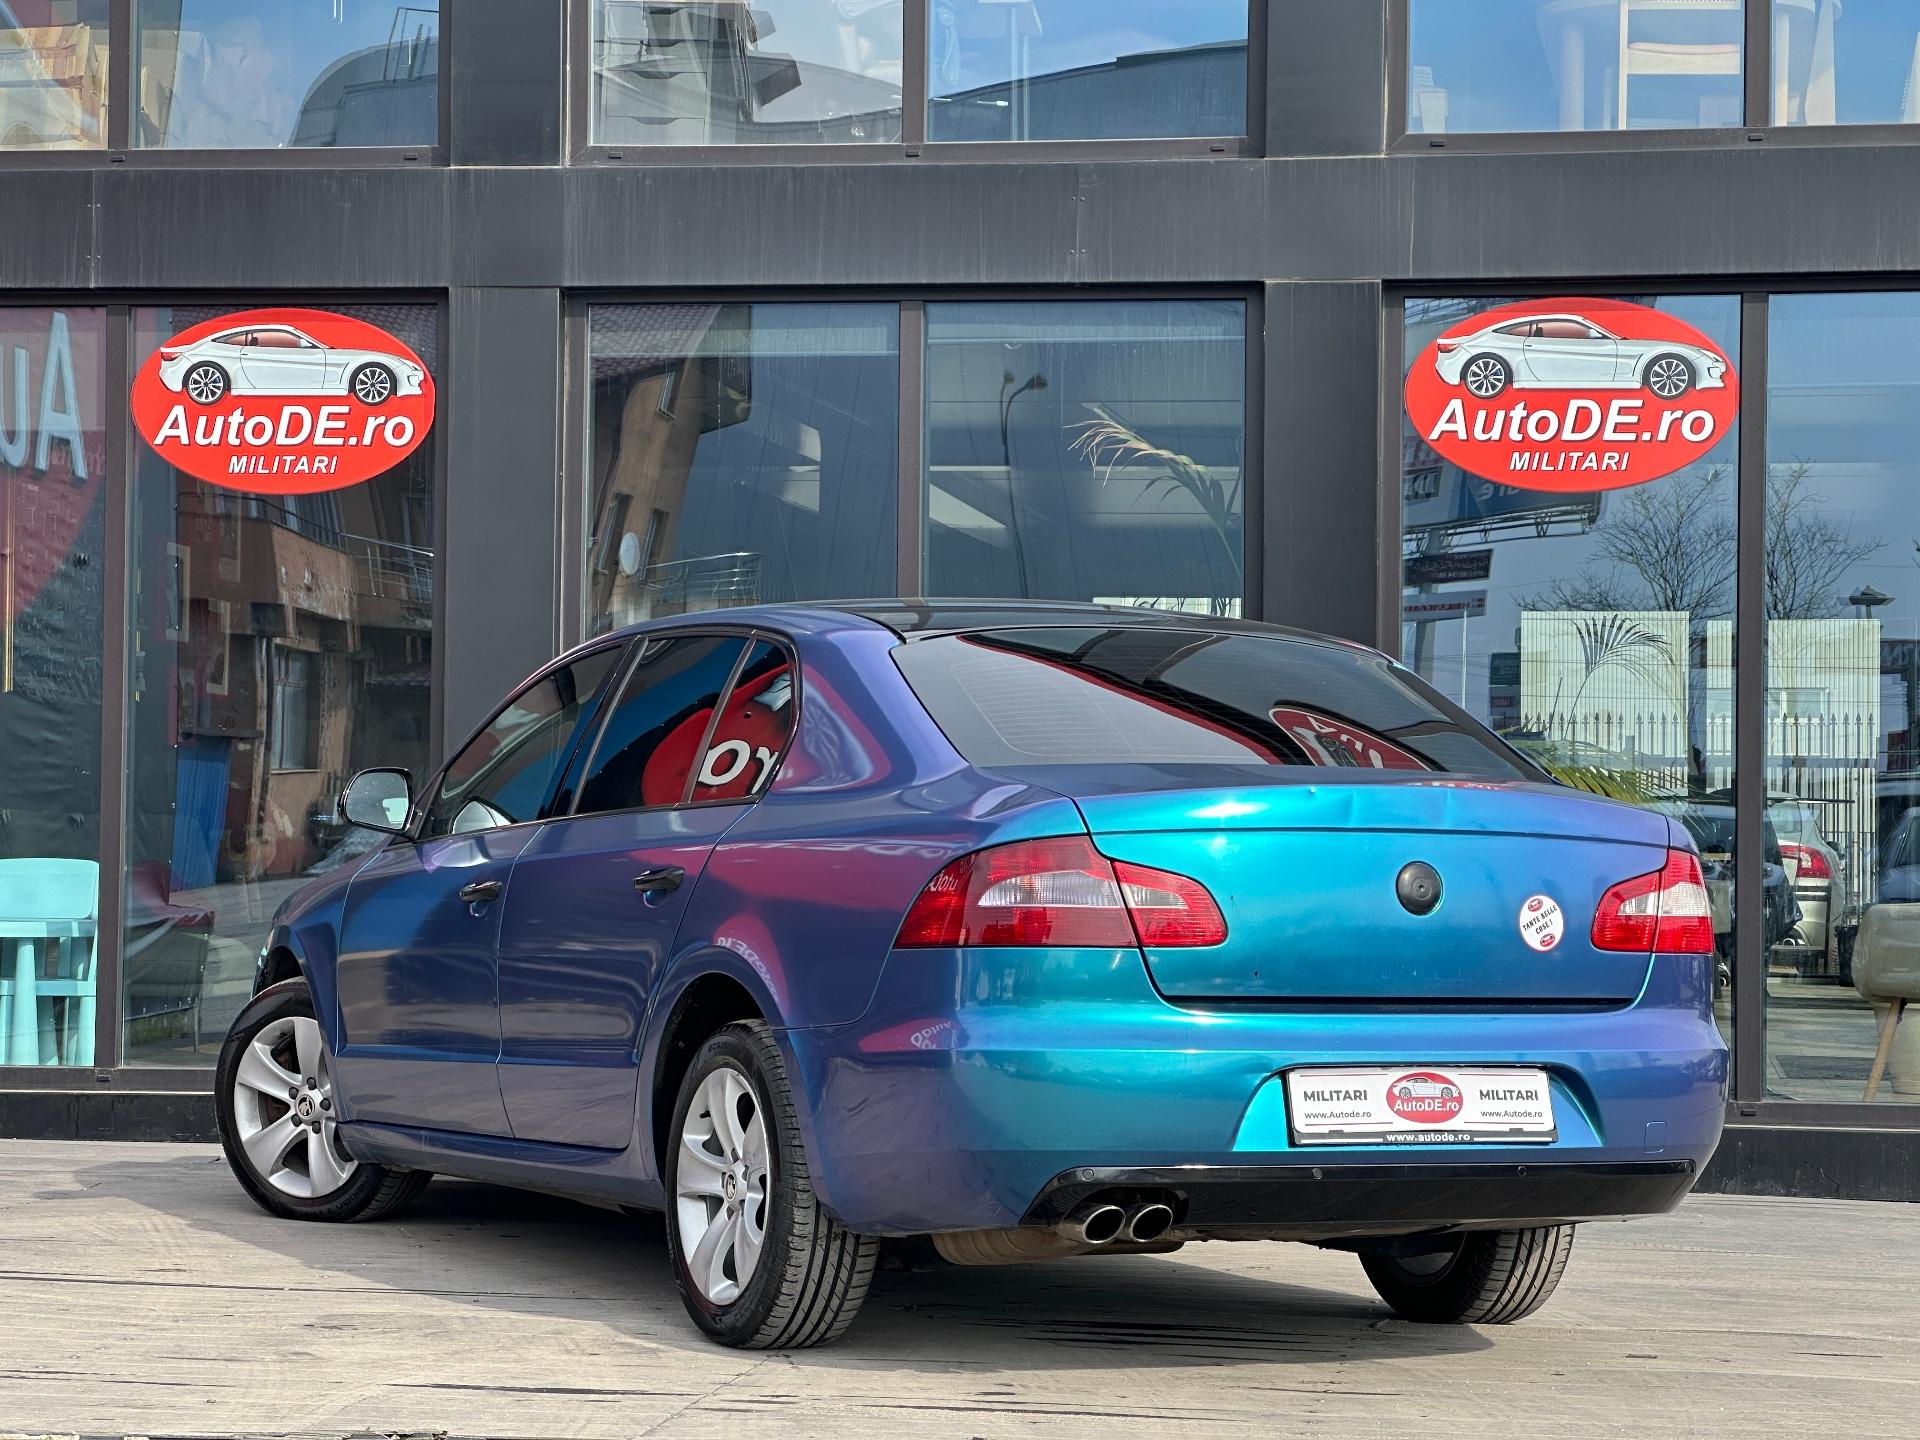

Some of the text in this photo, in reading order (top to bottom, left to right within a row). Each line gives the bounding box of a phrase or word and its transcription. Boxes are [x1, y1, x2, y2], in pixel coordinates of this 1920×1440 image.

[153, 405, 414, 447] AutoDE.ro
[1428, 398, 1715, 442] AutoDE.ro
[228, 455, 338, 474] MILITARI
[1509, 451, 1630, 471] MILITARI
[1522, 904, 1557, 931] TANTE BELLE
[1303, 1089, 1368, 1102] MILITARI
[1479, 1089, 1539, 1101] MILITARI
[1393, 1099, 1459, 1112] AutoDE.ro
[1304, 1110, 1372, 1119] www.Autode.ro
[1480, 1110, 1543, 1118] www.Autode.ro
[1386, 1132, 1471, 1142] www.autode.ro
